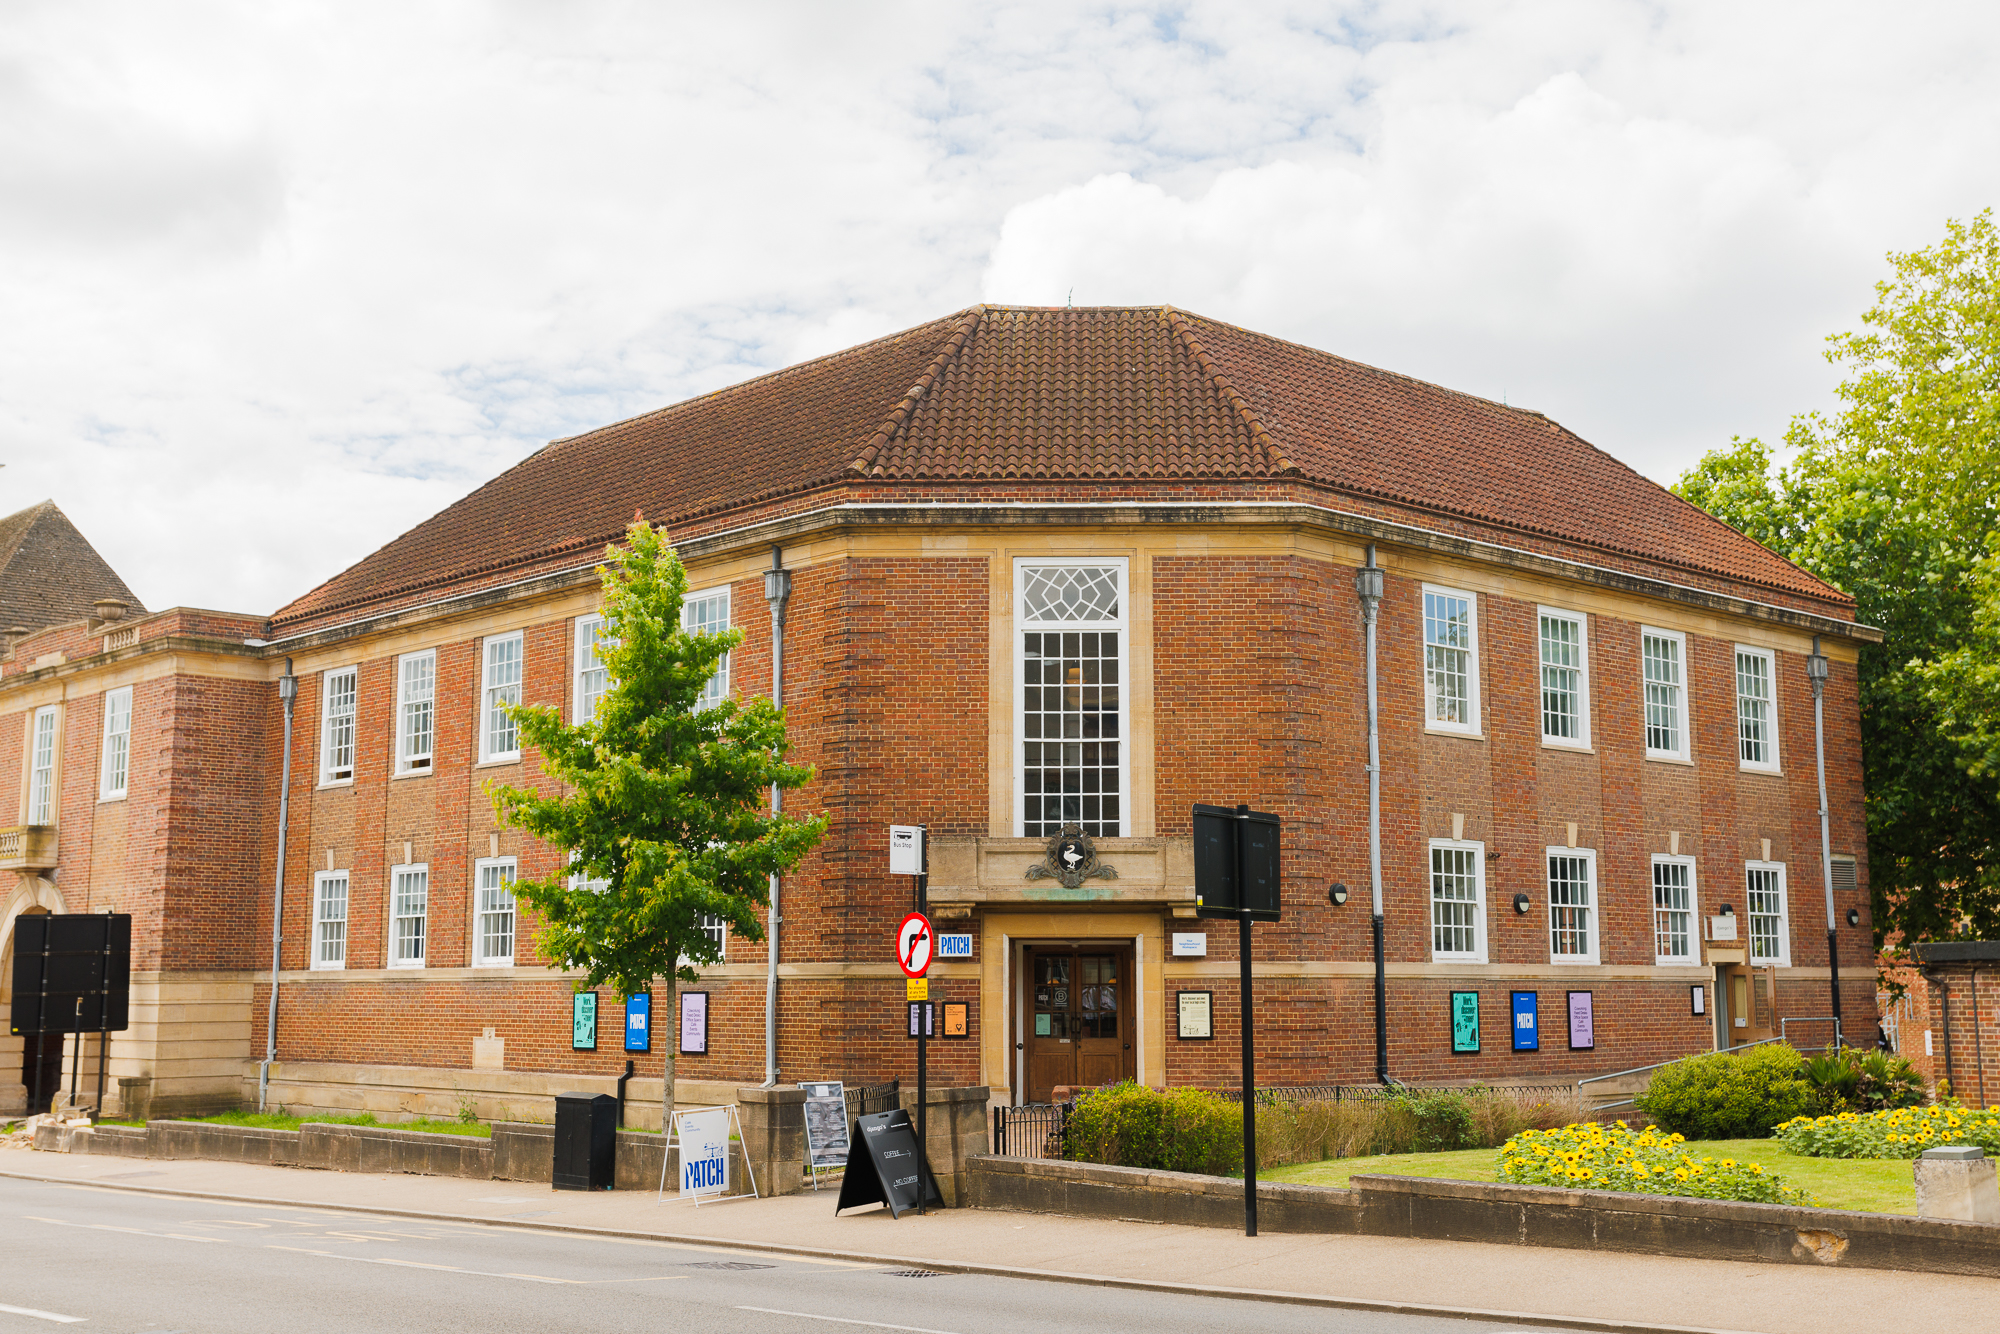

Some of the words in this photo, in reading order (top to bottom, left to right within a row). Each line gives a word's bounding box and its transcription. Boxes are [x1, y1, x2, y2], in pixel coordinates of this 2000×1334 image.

[941, 936, 970, 954] PATCH
[630, 1013, 645, 1029] PATCH
[1517, 1013, 1534, 1029] PATCH
[866, 1124, 886, 1132] django's
[685, 1158, 724, 1190] PATCH
